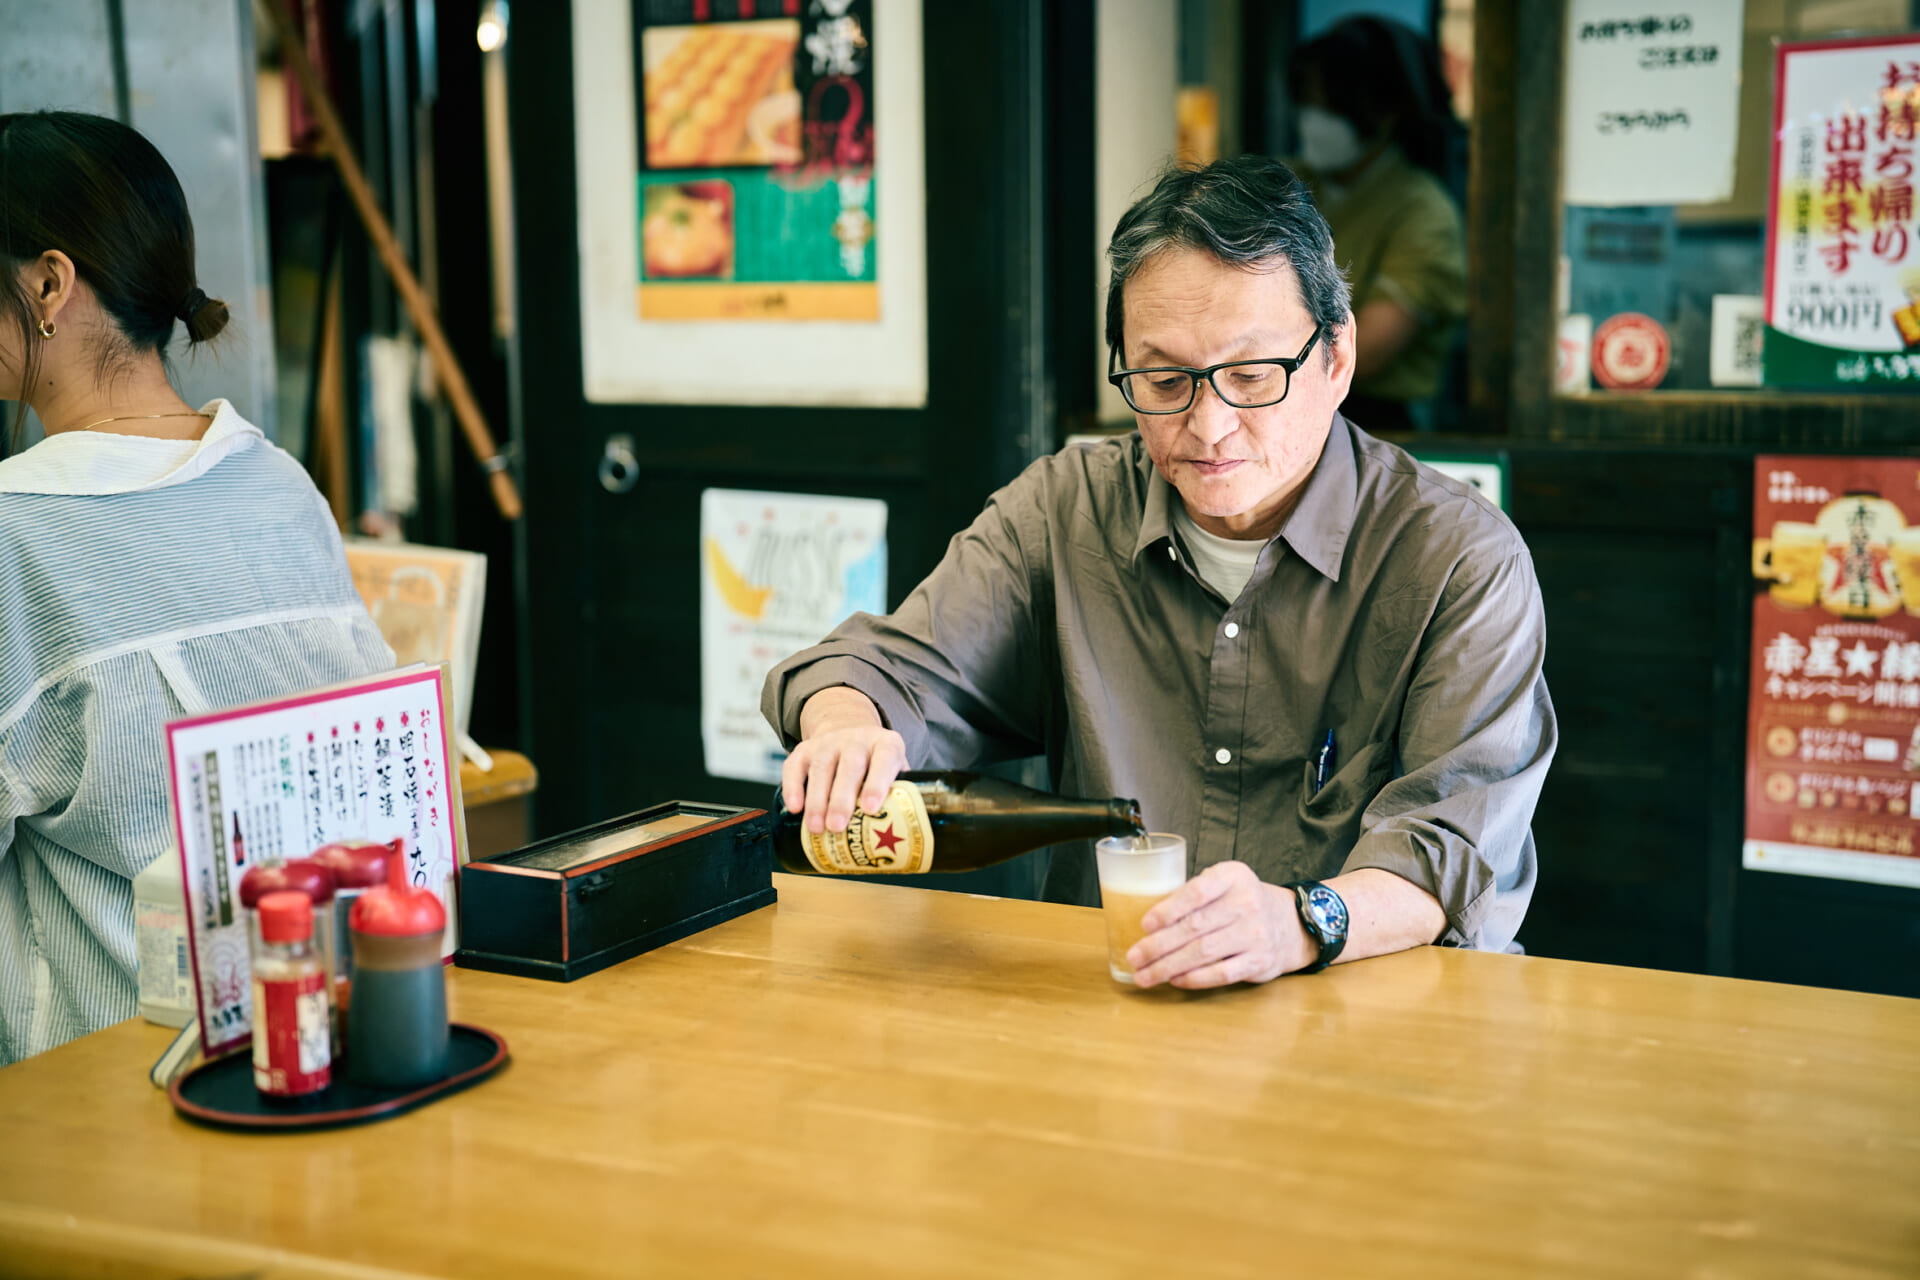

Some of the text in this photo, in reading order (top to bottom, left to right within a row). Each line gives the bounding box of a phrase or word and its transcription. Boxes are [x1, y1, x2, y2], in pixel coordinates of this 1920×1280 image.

[1818, 116, 1866, 276] 出来ます
[1787, 301, 1882, 332] 900円
[420, 708, 438, 828] おしながき
[848, 807, 869, 866] SAPPORO
